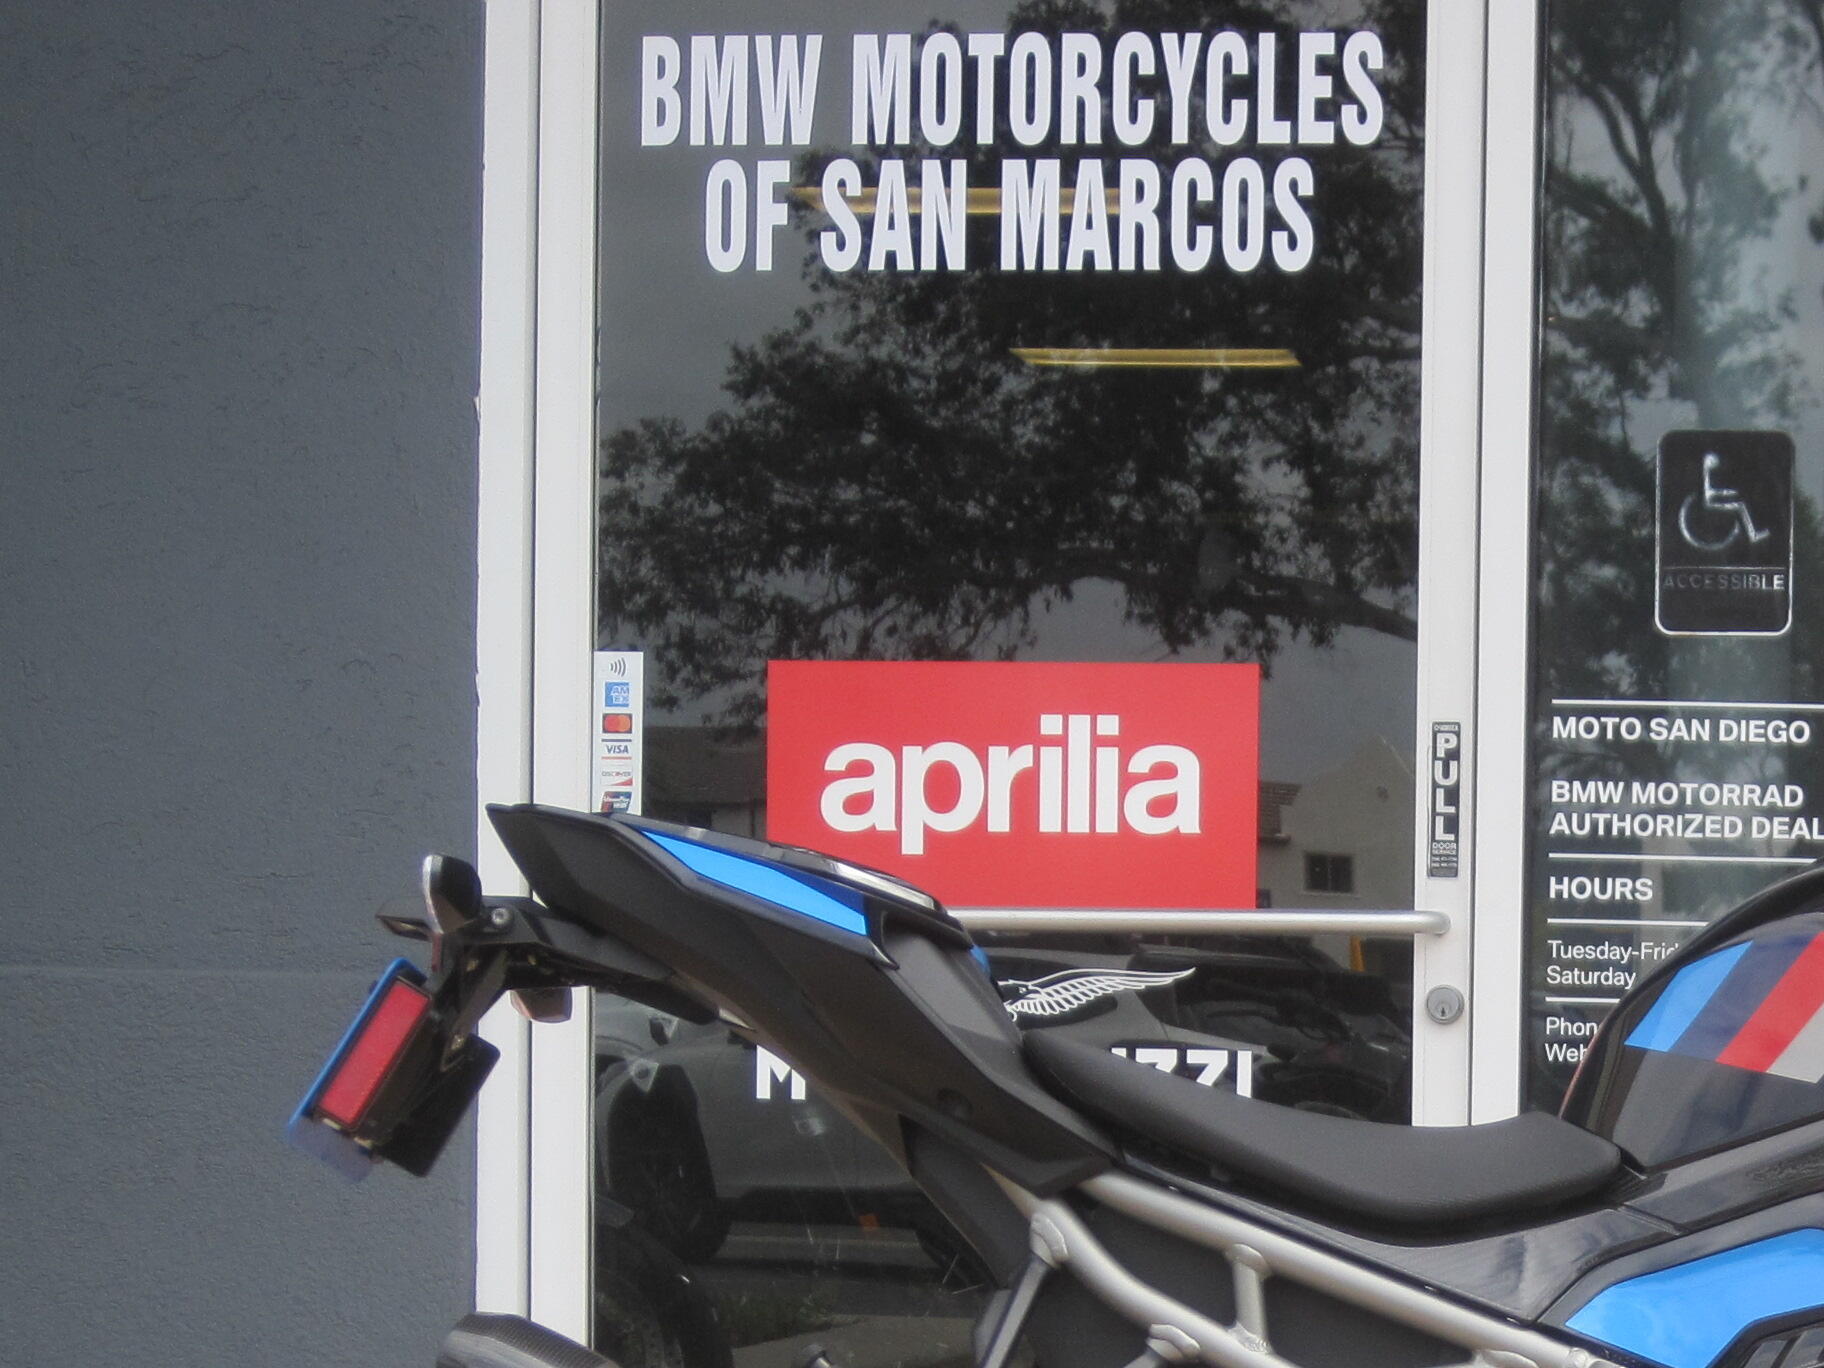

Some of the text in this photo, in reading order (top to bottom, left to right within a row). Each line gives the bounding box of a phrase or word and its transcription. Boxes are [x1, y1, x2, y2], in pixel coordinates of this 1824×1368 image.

[641, 31, 1385, 147] BMW MOTORCYCLES
[704, 157, 1316, 273] OF SAN MARCOS
[1664, 574, 1785, 590] ACCESSIBLE
[1552, 716, 1810, 744] MOTO SAN DIEGO
[606, 744, 629, 754] VISA
[819, 714, 1201, 855] aprilia
[1434, 732, 1458, 841] PULL
[1551, 780, 1804, 807] BMW MOTORRAD
[1549, 812, 1743, 839] AUTHORIZED
[1549, 876, 1653, 901] HOURS
[1546, 965, 1637, 990] Saturday
[1545, 1016, 1602, 1036] Phon
